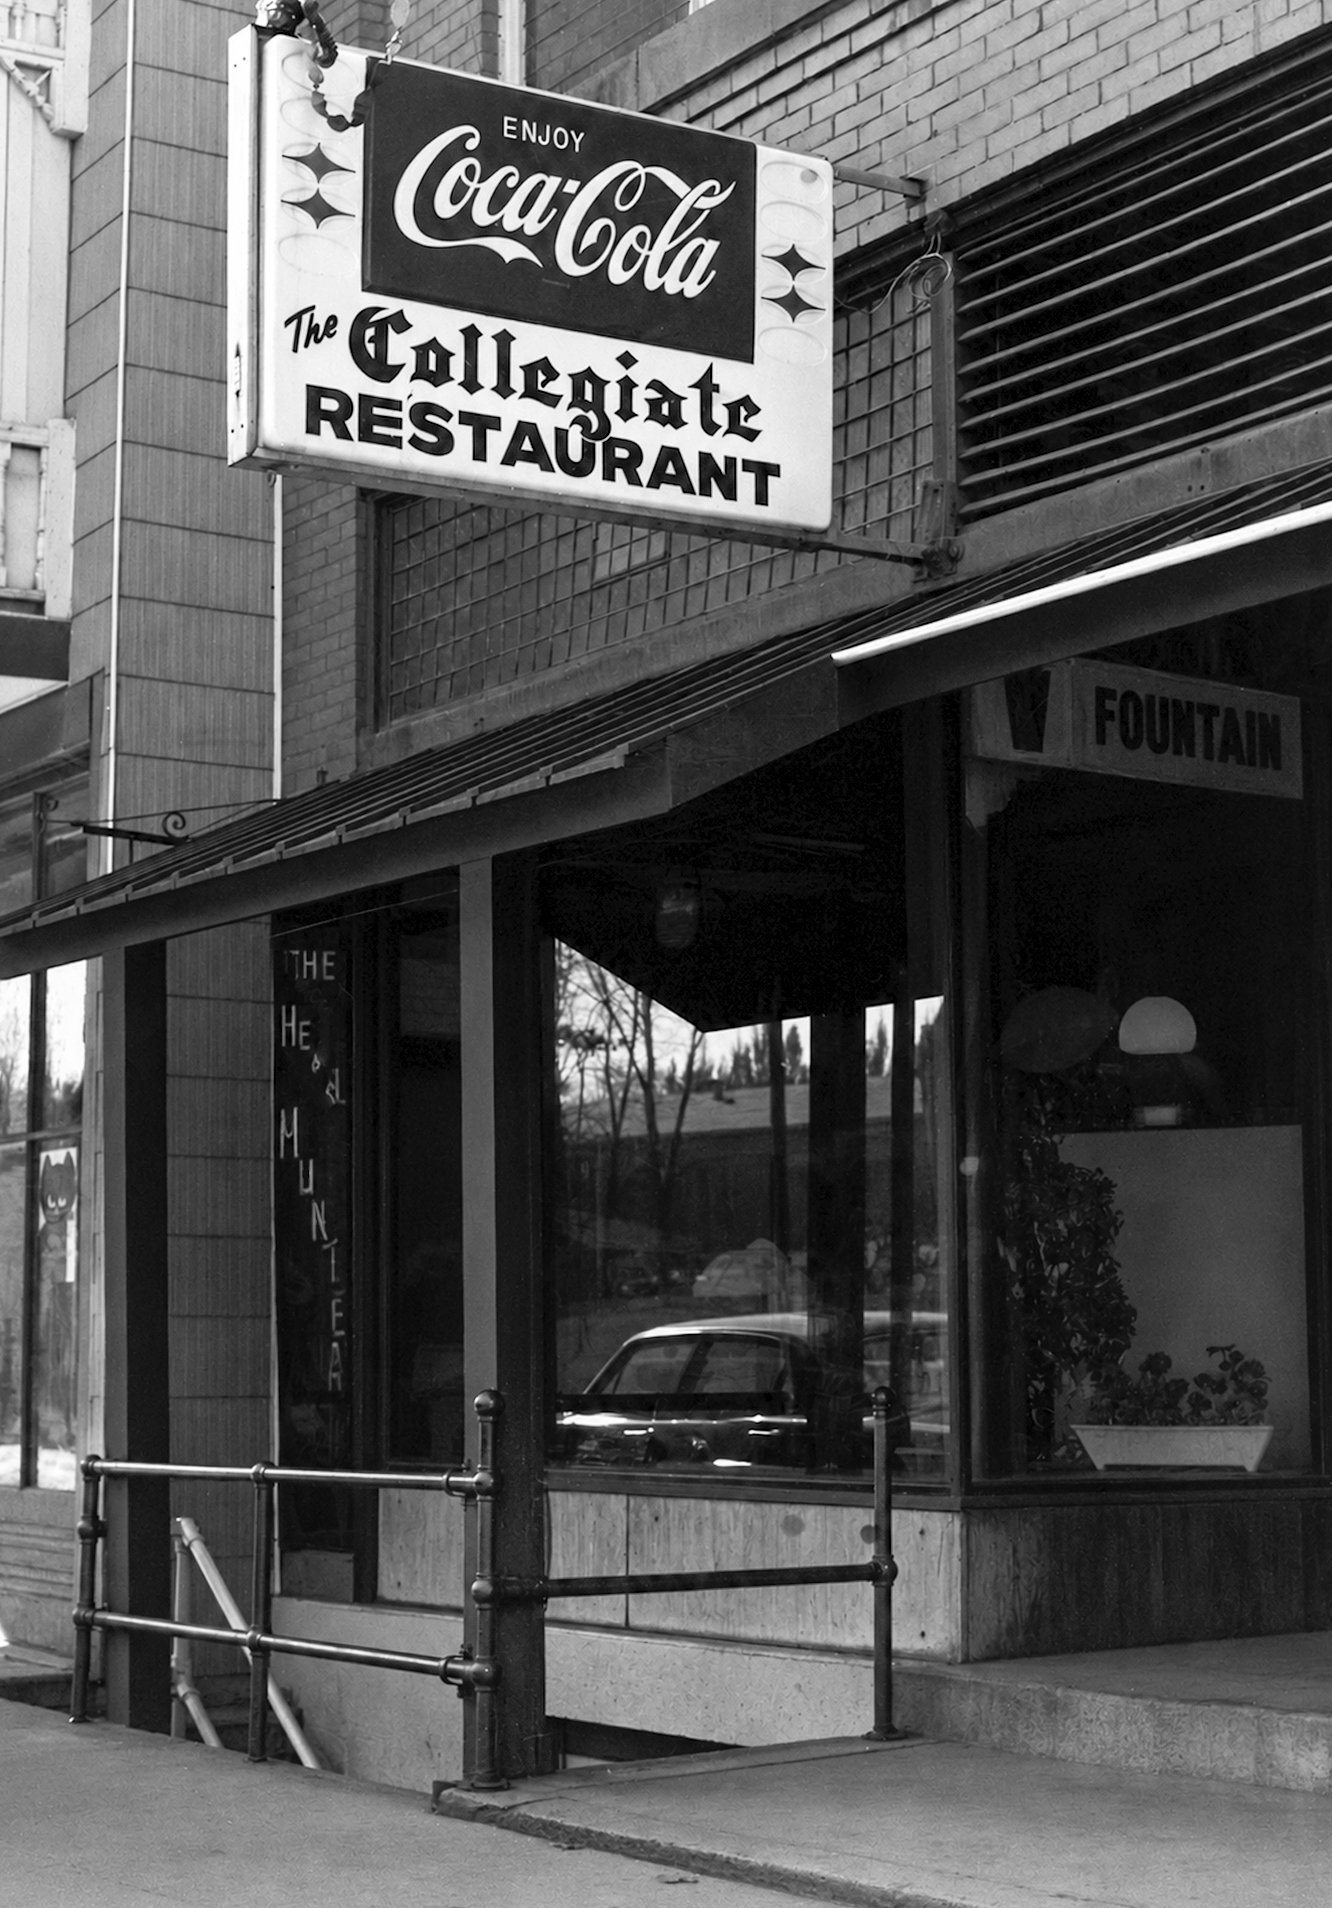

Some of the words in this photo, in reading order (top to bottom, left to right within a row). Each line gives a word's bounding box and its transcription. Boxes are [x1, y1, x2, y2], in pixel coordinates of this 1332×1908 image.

[502, 115, 587, 153] ENJOY
[393, 125, 736, 298] Coca-Cola
[284, 304, 339, 355] The
[348, 306, 763, 444] Collegiate
[304, 384, 781, 507] RESTAURANT
[1094, 685, 1282, 771] FOUNTAIN
